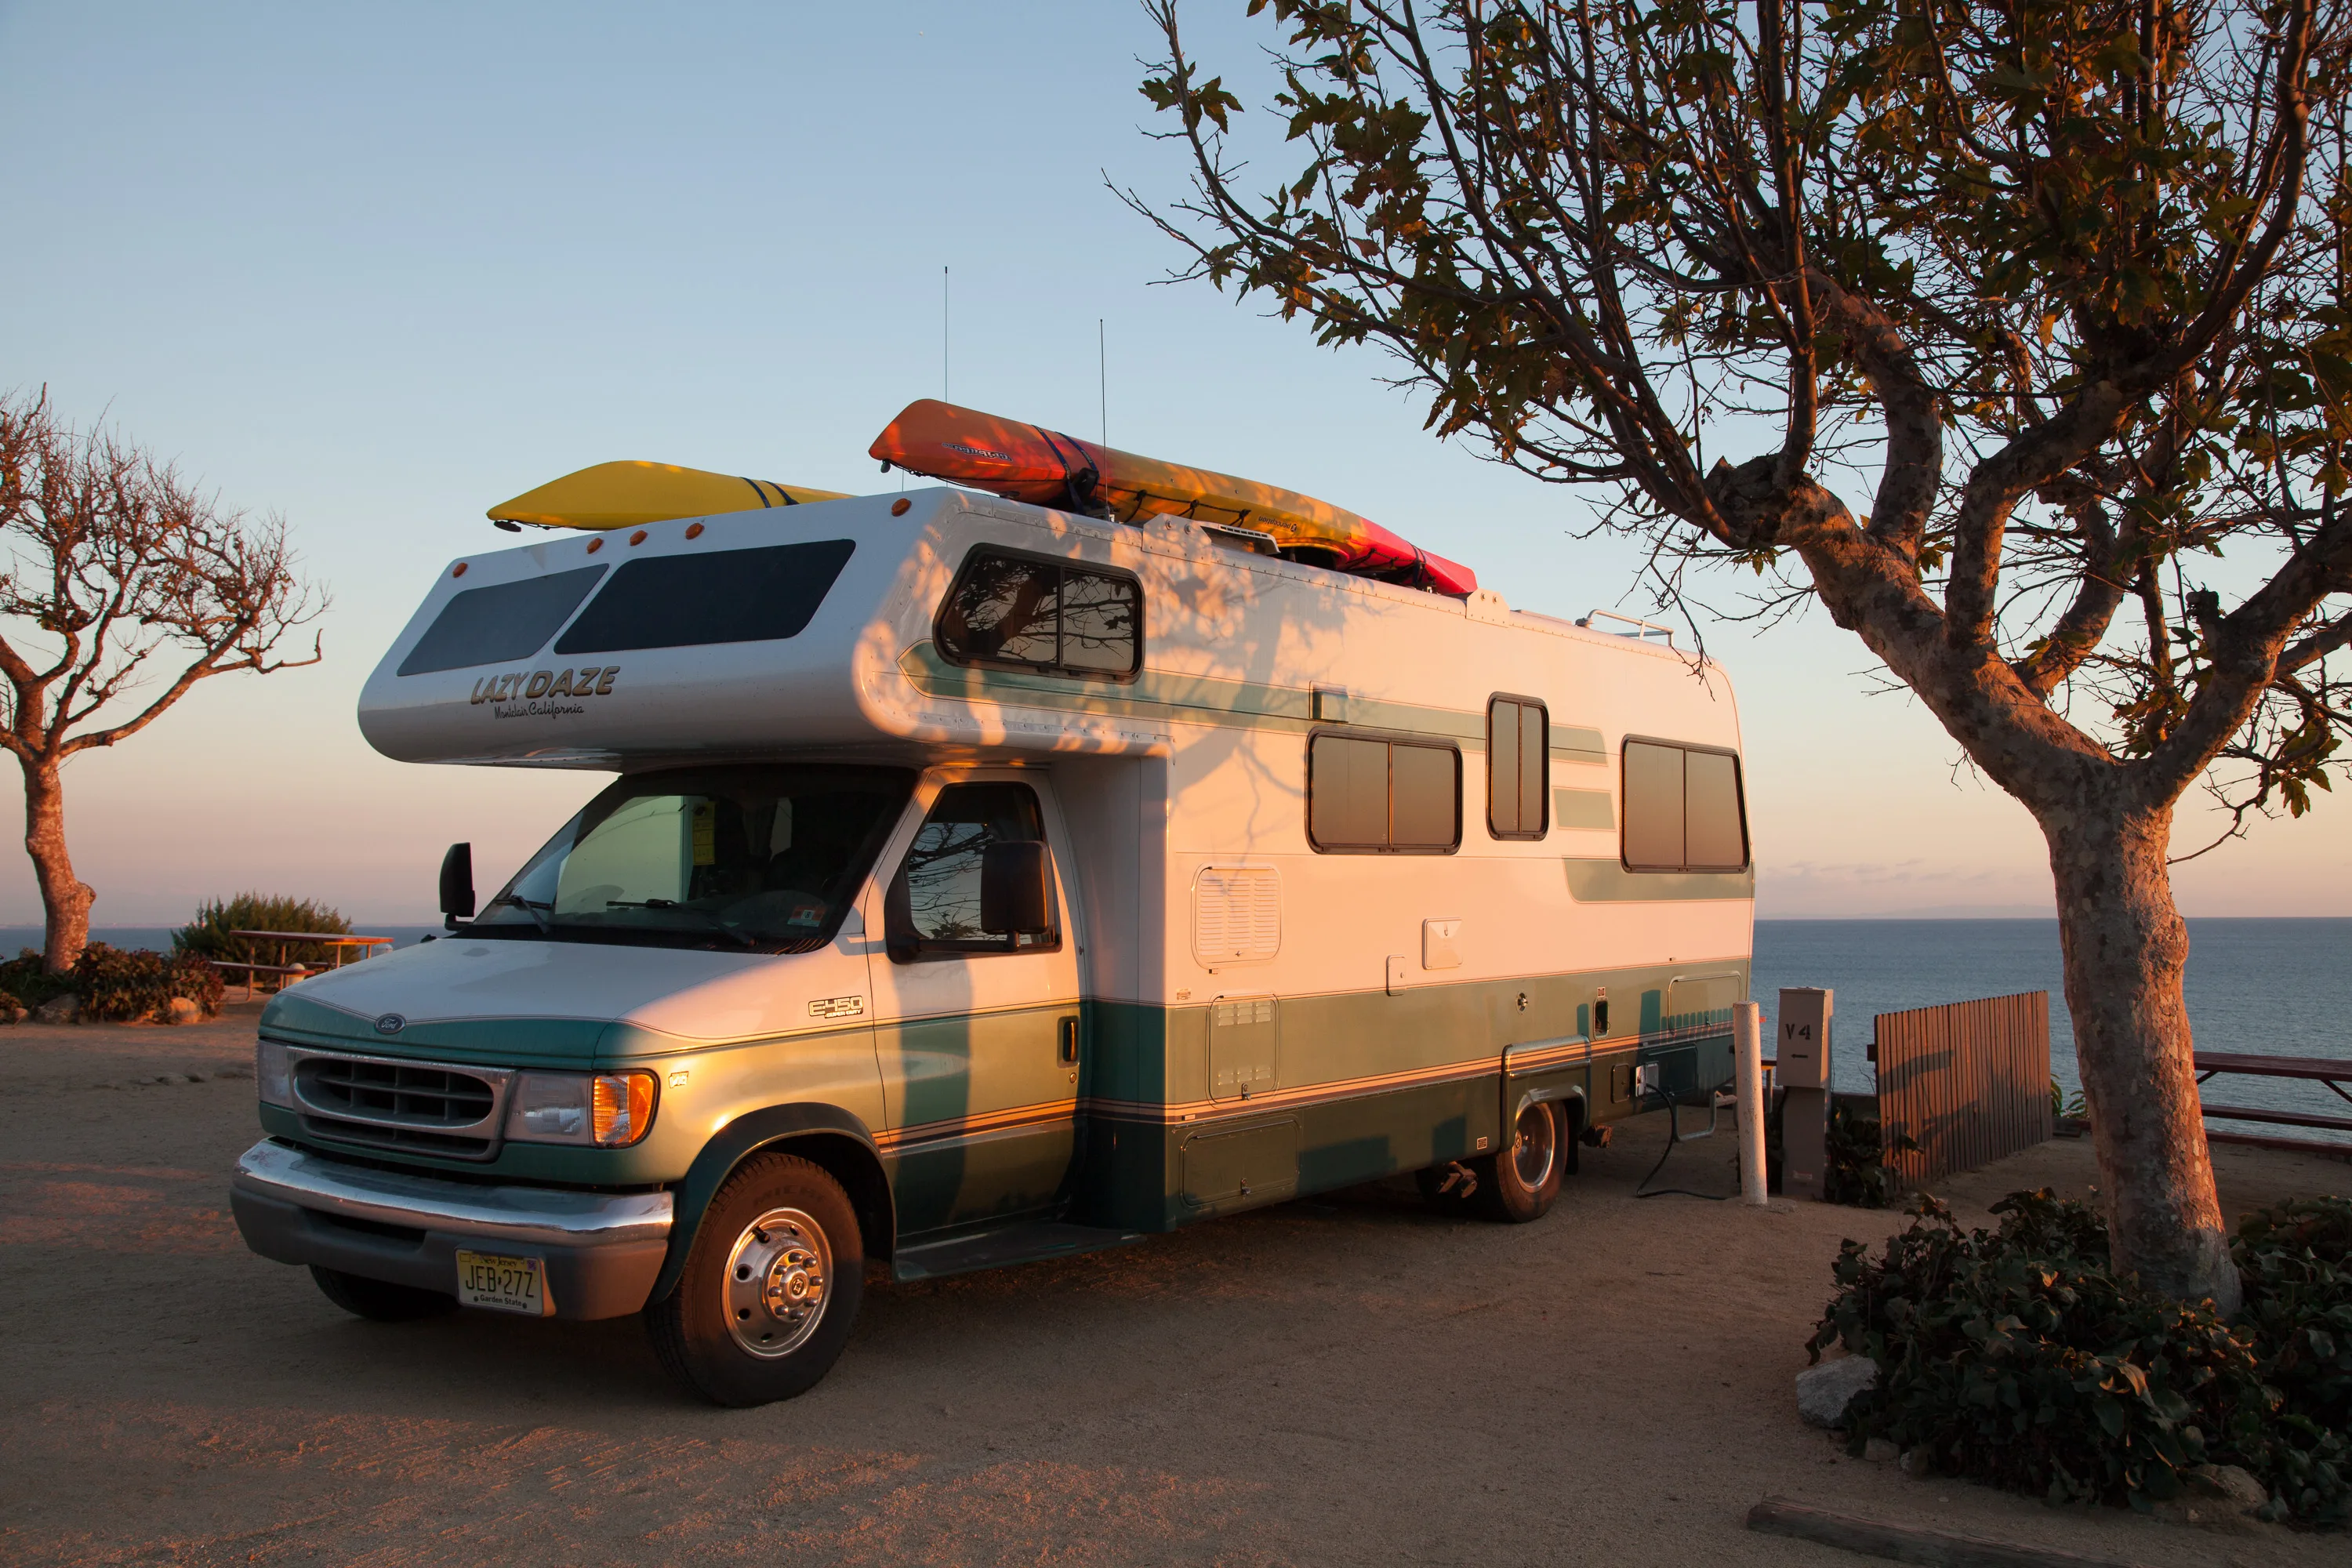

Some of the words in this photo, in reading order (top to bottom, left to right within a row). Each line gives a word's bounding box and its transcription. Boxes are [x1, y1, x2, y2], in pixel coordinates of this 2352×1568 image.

[1258, 516, 1292, 529] perception
[470, 671, 530, 705] LAZY
[525, 666, 621, 699] DAZE
[528, 701, 585, 720] California
[808, 996, 863, 1016] E-450
[381, 1018, 398, 1029] Ford
[496, 1254, 518, 1267] Jersey
[480, 1294, 503, 1304] Garden
[504, 1298, 522, 1307] State
